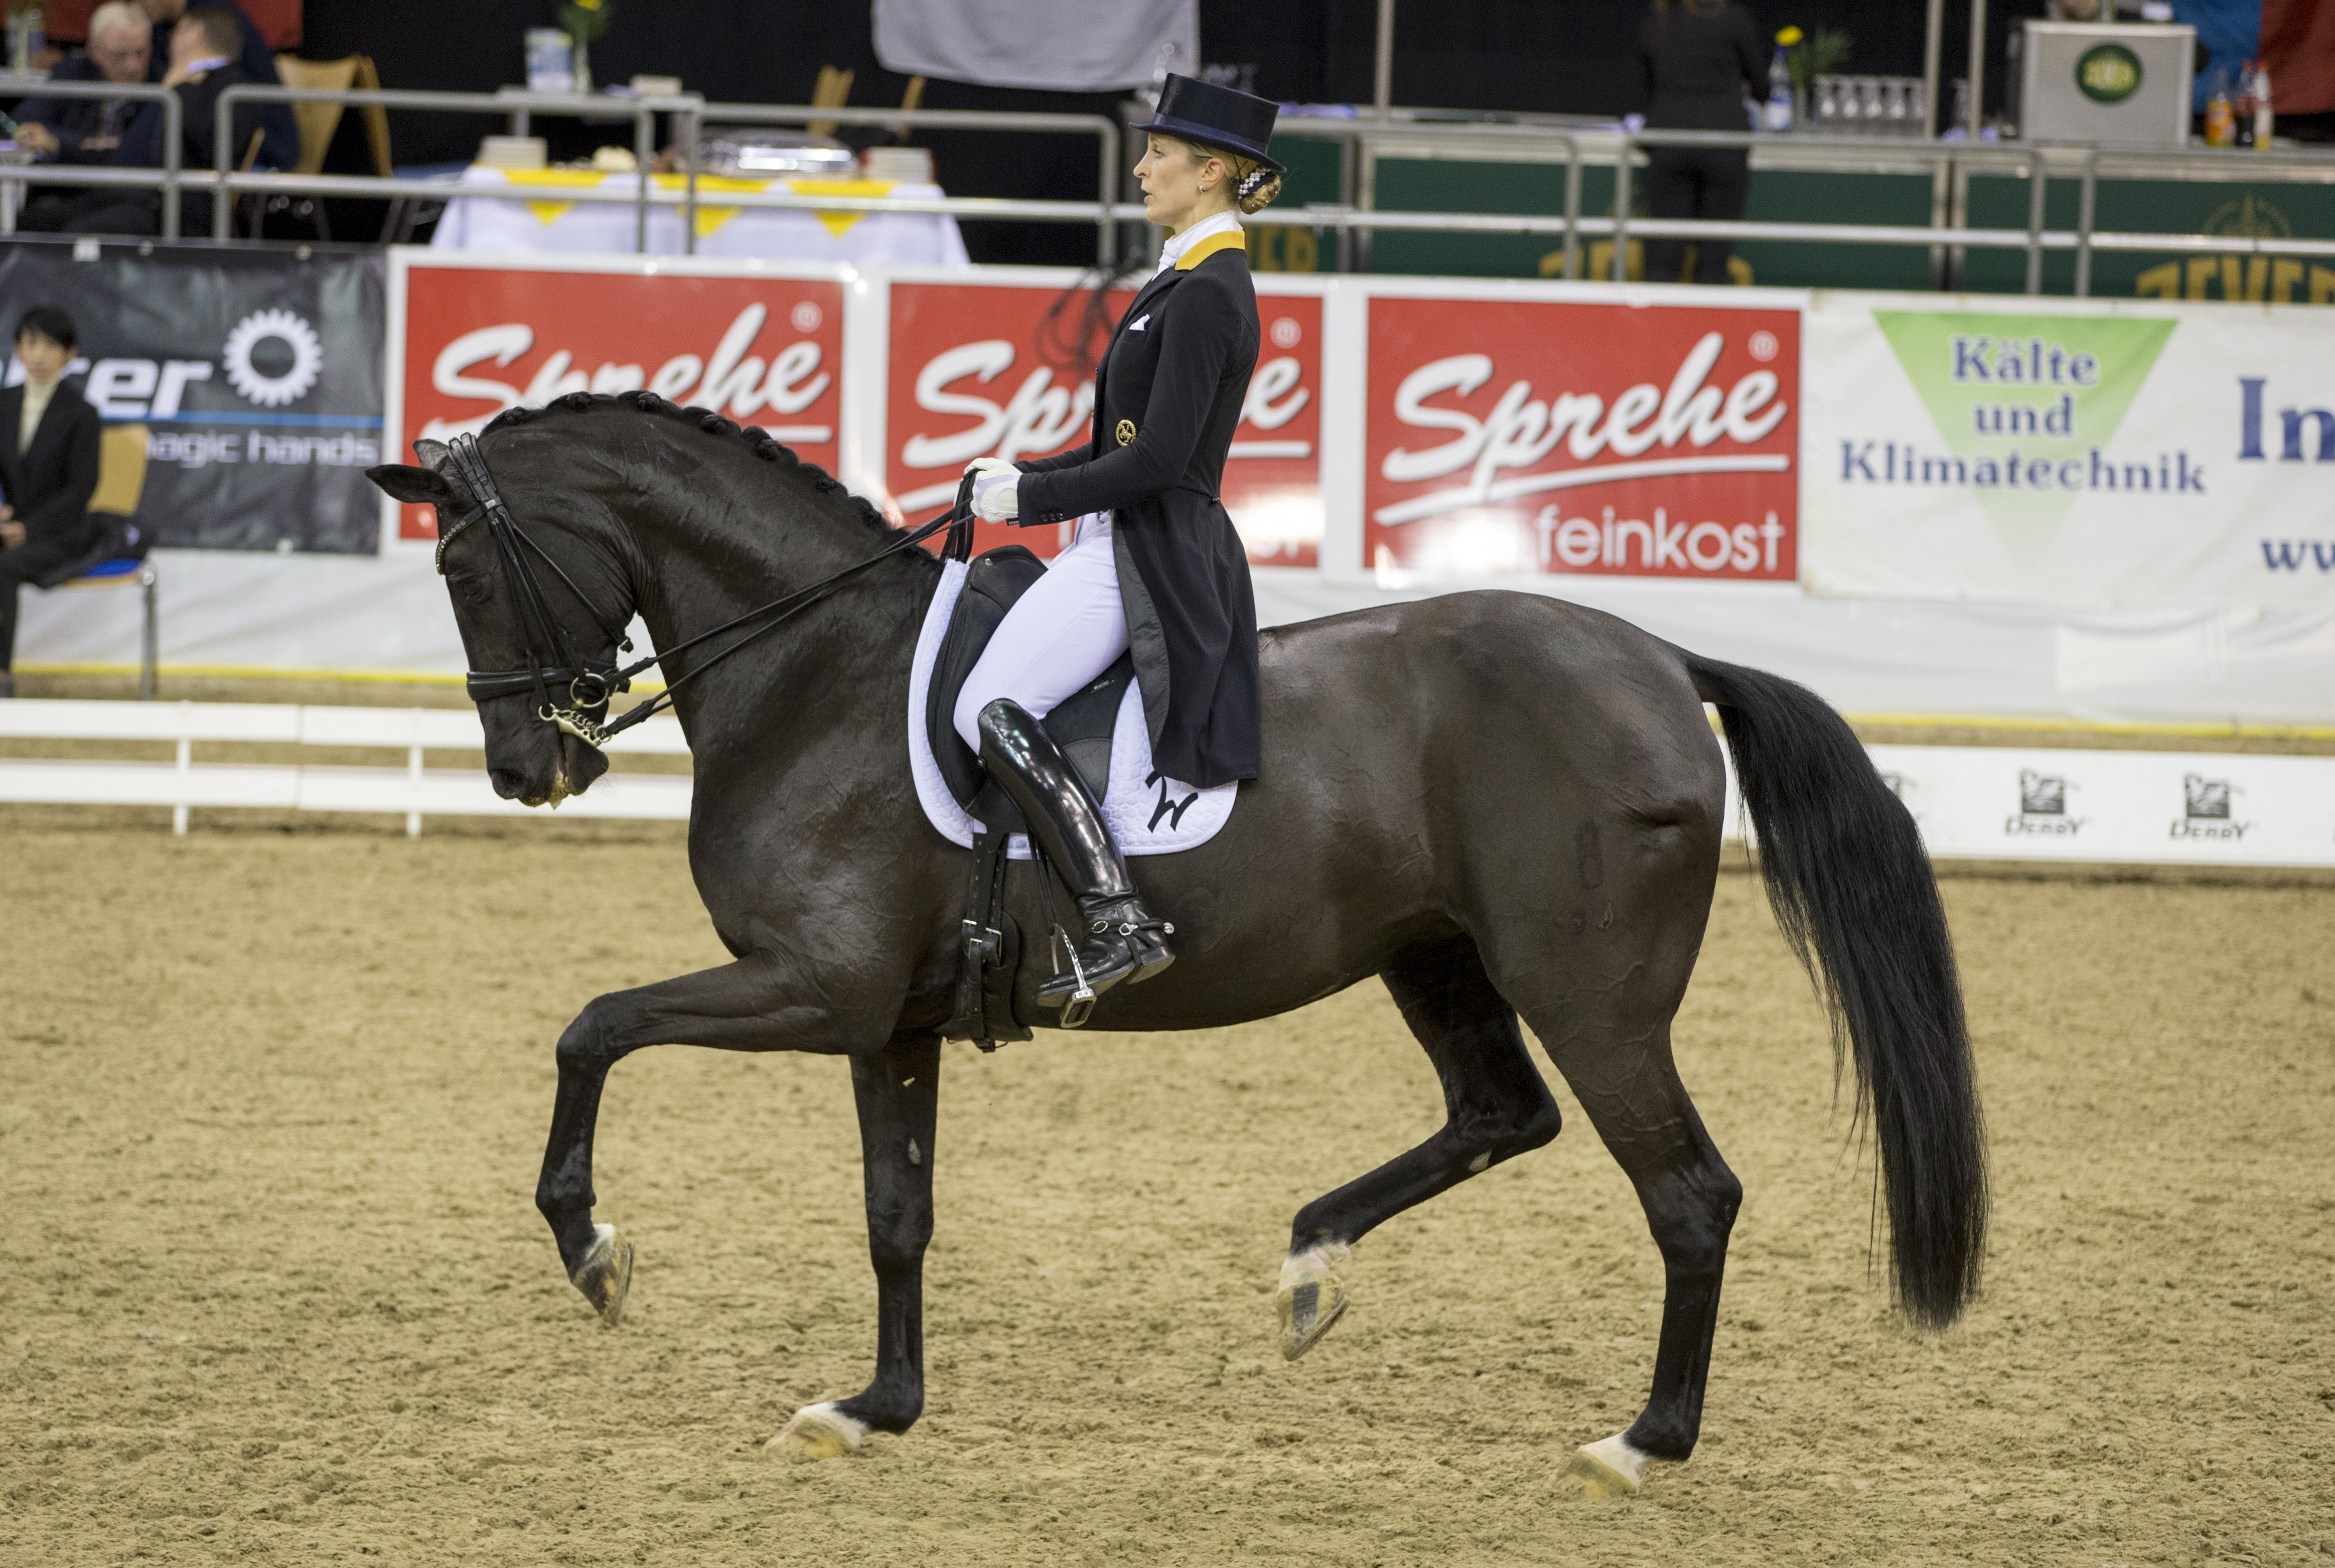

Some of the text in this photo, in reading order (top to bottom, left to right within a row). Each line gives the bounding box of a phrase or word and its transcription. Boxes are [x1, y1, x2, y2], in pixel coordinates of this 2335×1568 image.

[1952, 335, 2098, 385] Kälte
[1382, 331, 1787, 501] Sprehe
[1975, 393, 2075, 437] und
[147, 429, 380, 468] agic hands
[1840, 440, 2207, 495] Klimatechnik
[1537, 504, 1785, 572] feinkost
